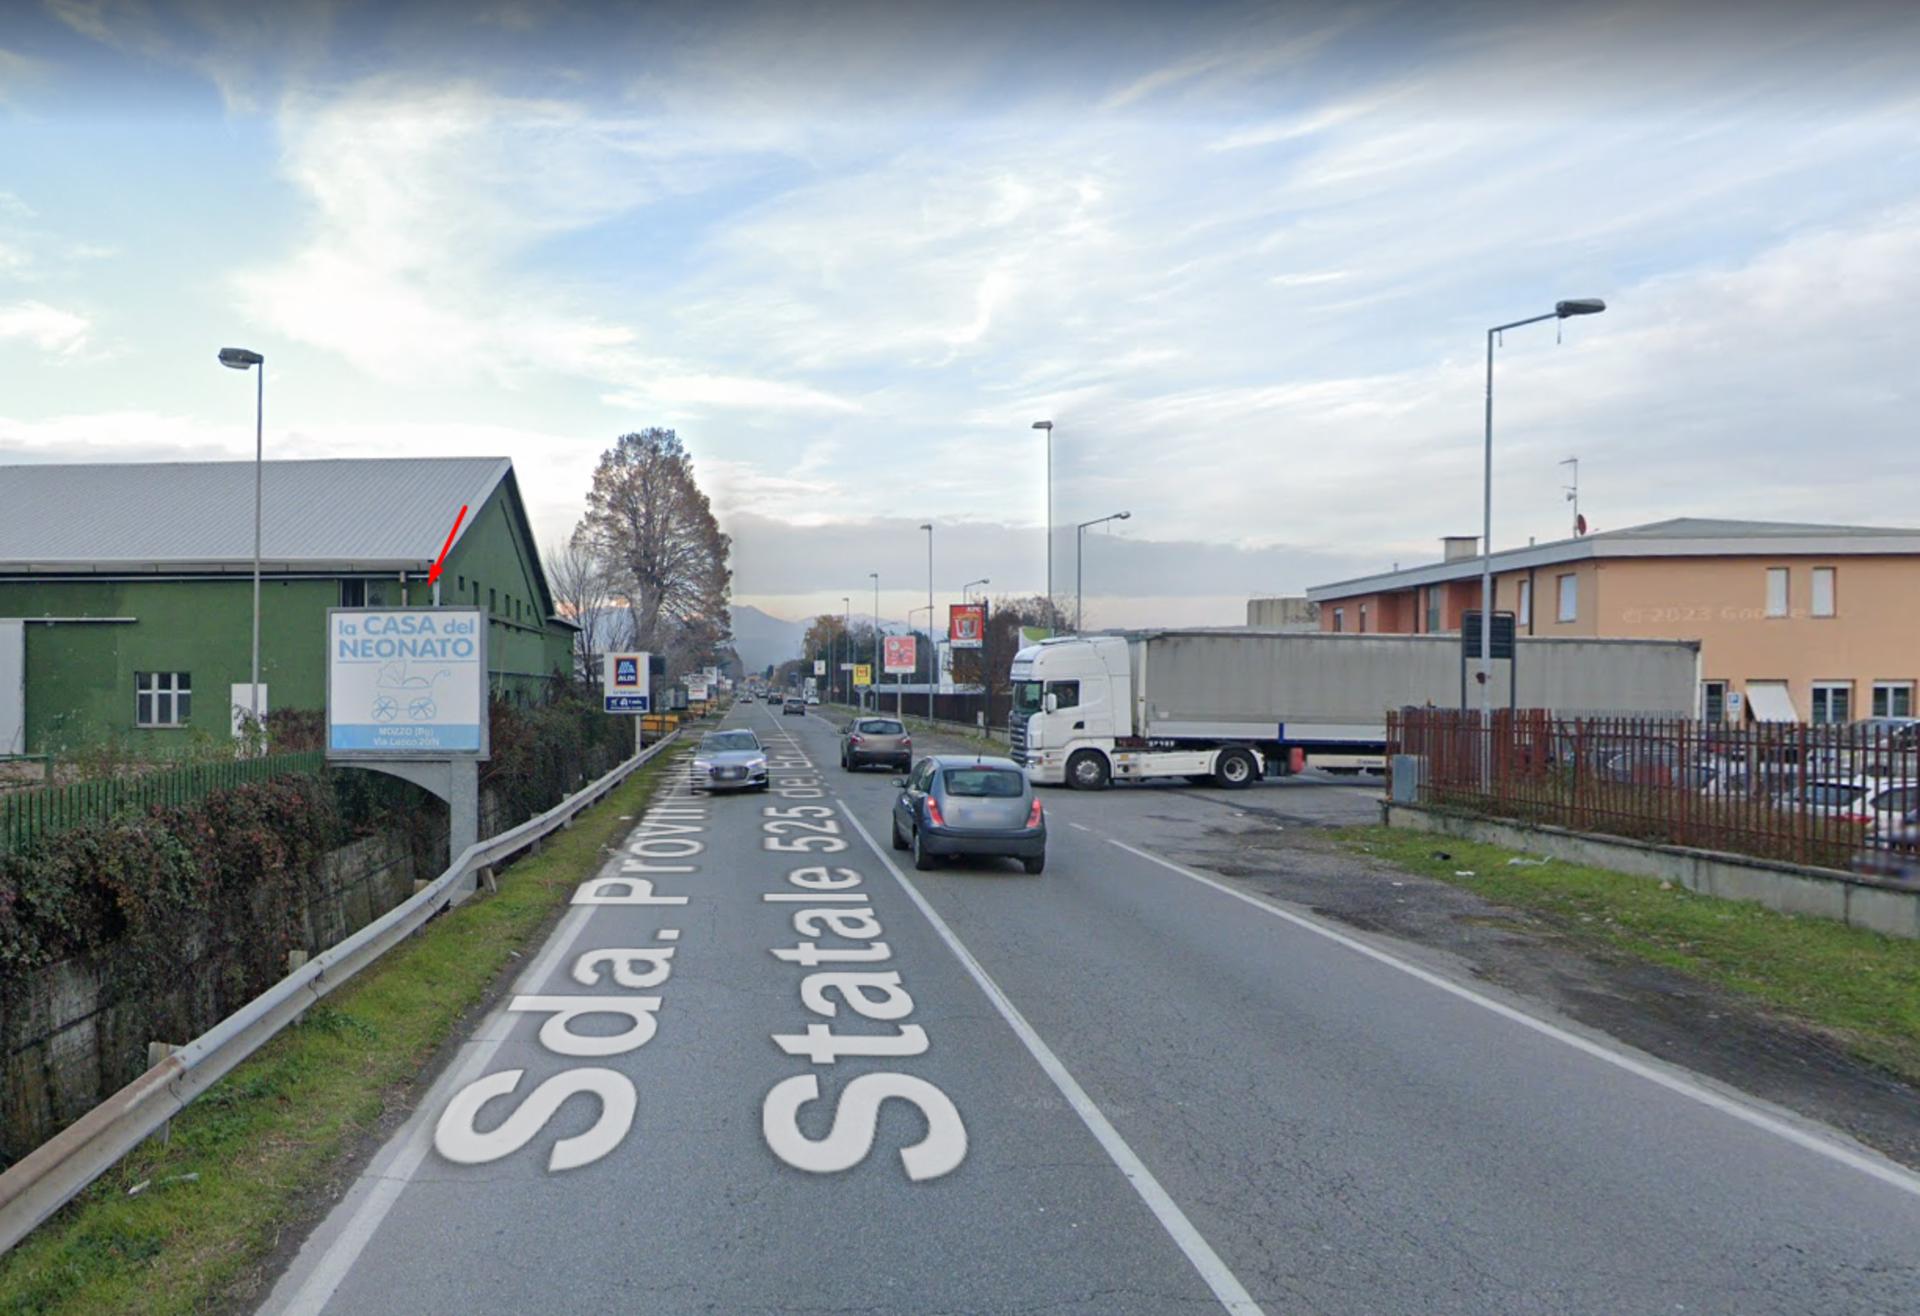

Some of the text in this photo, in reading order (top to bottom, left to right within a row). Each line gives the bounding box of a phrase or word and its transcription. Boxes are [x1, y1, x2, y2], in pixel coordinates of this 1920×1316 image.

[339, 616, 474, 635] la CASA del
[339, 638, 474, 657] NEONATO
